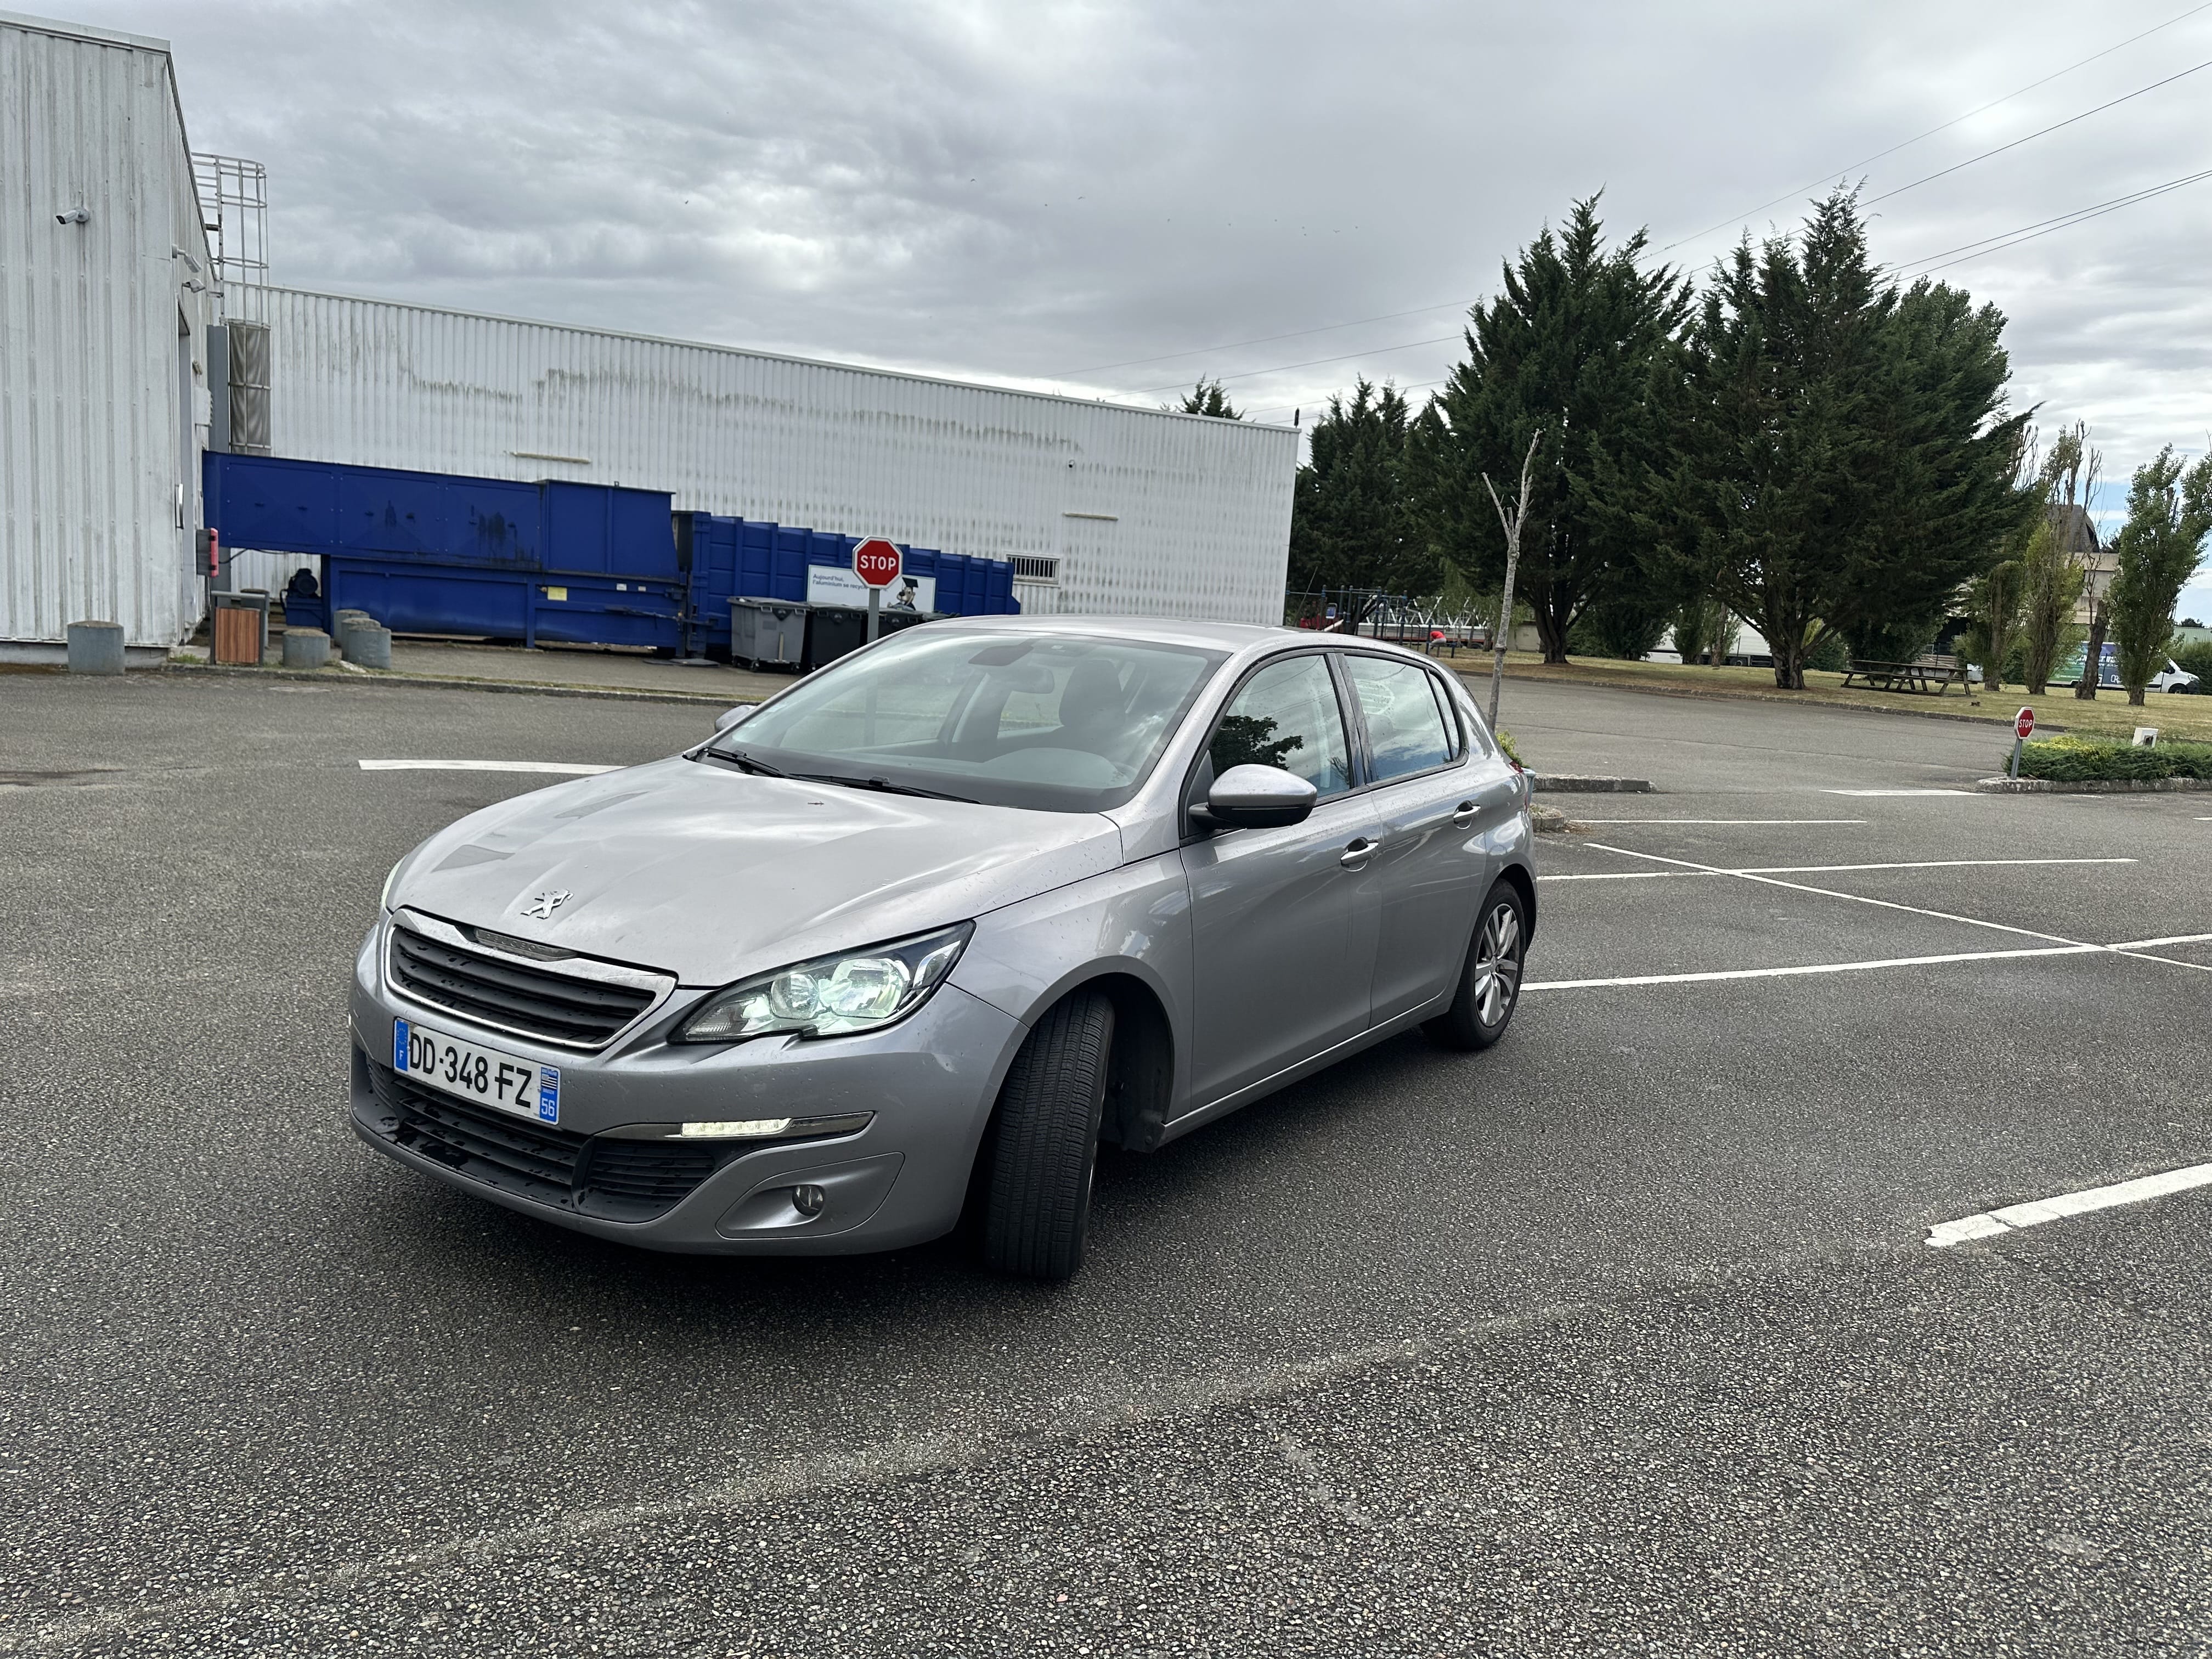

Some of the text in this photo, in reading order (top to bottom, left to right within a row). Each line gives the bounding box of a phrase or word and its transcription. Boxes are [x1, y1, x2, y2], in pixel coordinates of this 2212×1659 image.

[860, 555, 896, 571] STOP
[813, 574, 844, 582] Aujourd'hui,
[2019, 719, 2033, 728] STOP
[399, 1049, 404, 1060] F
[541, 1097, 555, 1117] 56
